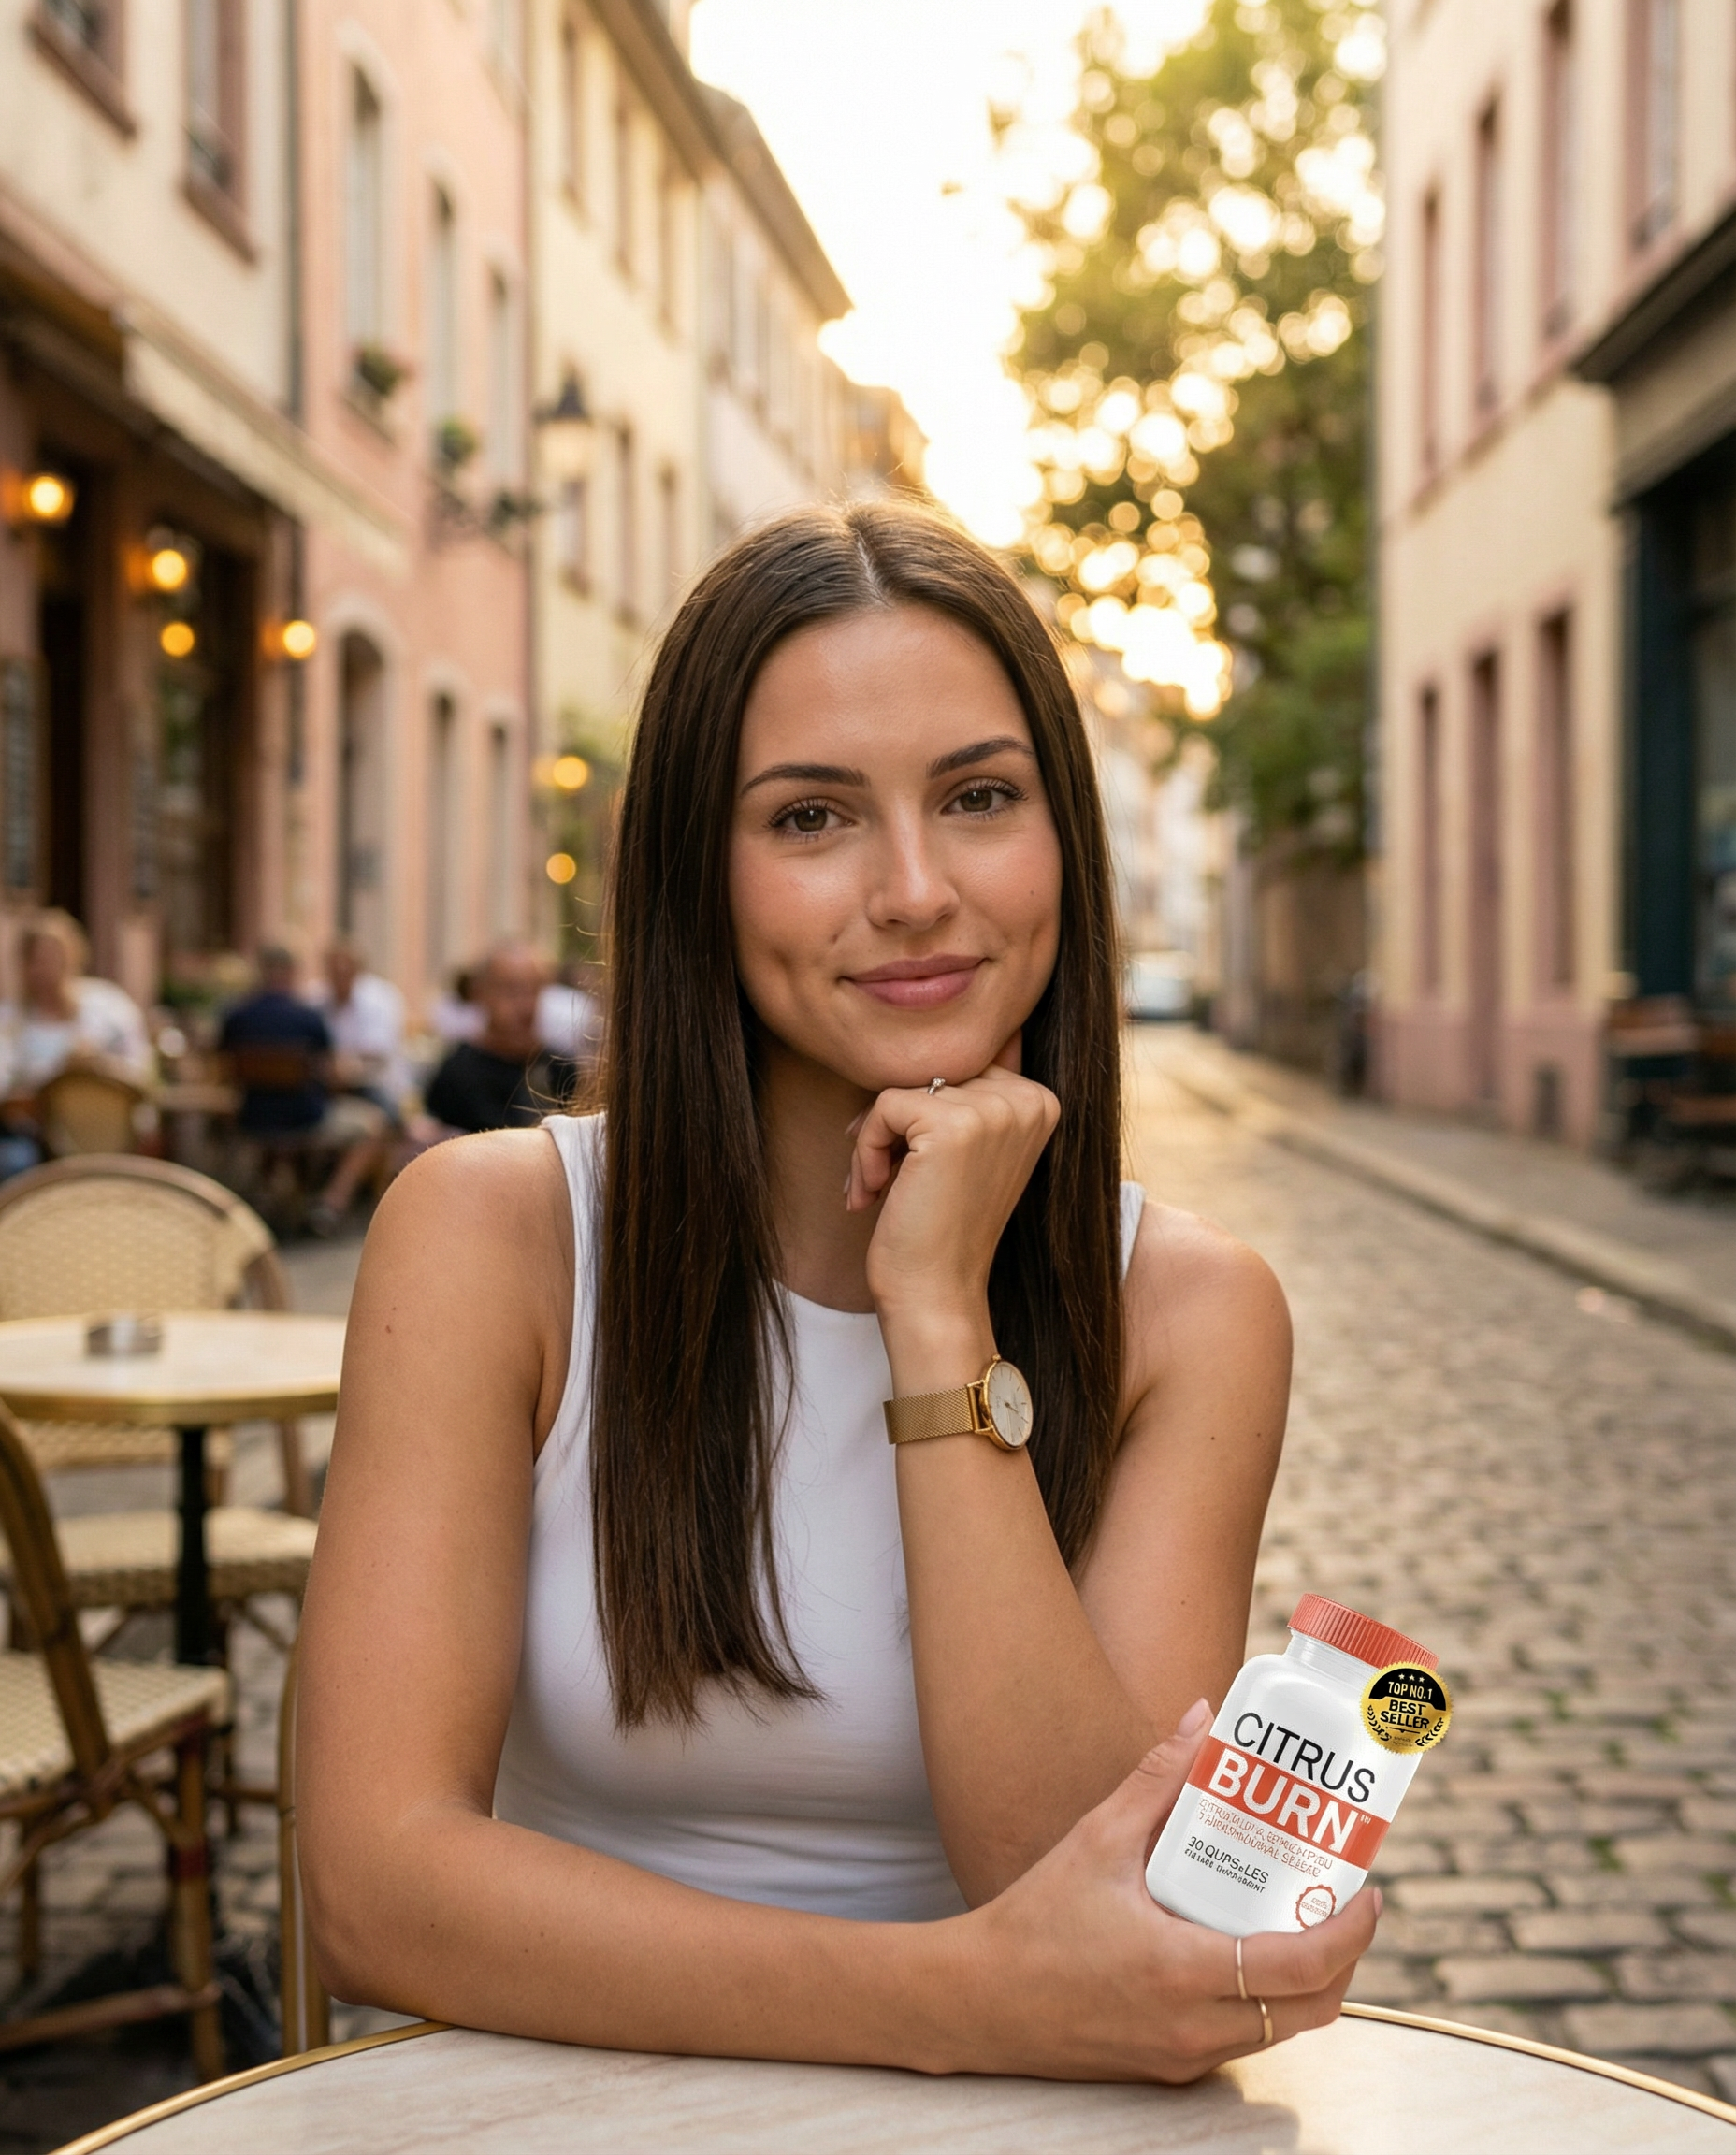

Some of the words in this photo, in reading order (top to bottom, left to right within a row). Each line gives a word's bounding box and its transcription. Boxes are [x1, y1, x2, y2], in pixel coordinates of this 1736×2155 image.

[1388, 1682, 1409, 1696] TOP
[1409, 1685, 1433, 1700] NO.1
[1388, 1699, 1426, 1715] BEST
[1380, 1711, 1430, 1729] SELLER
[1233, 1712, 1376, 1803] CITRUS
[1187, 1836, 1206, 1851] 30
